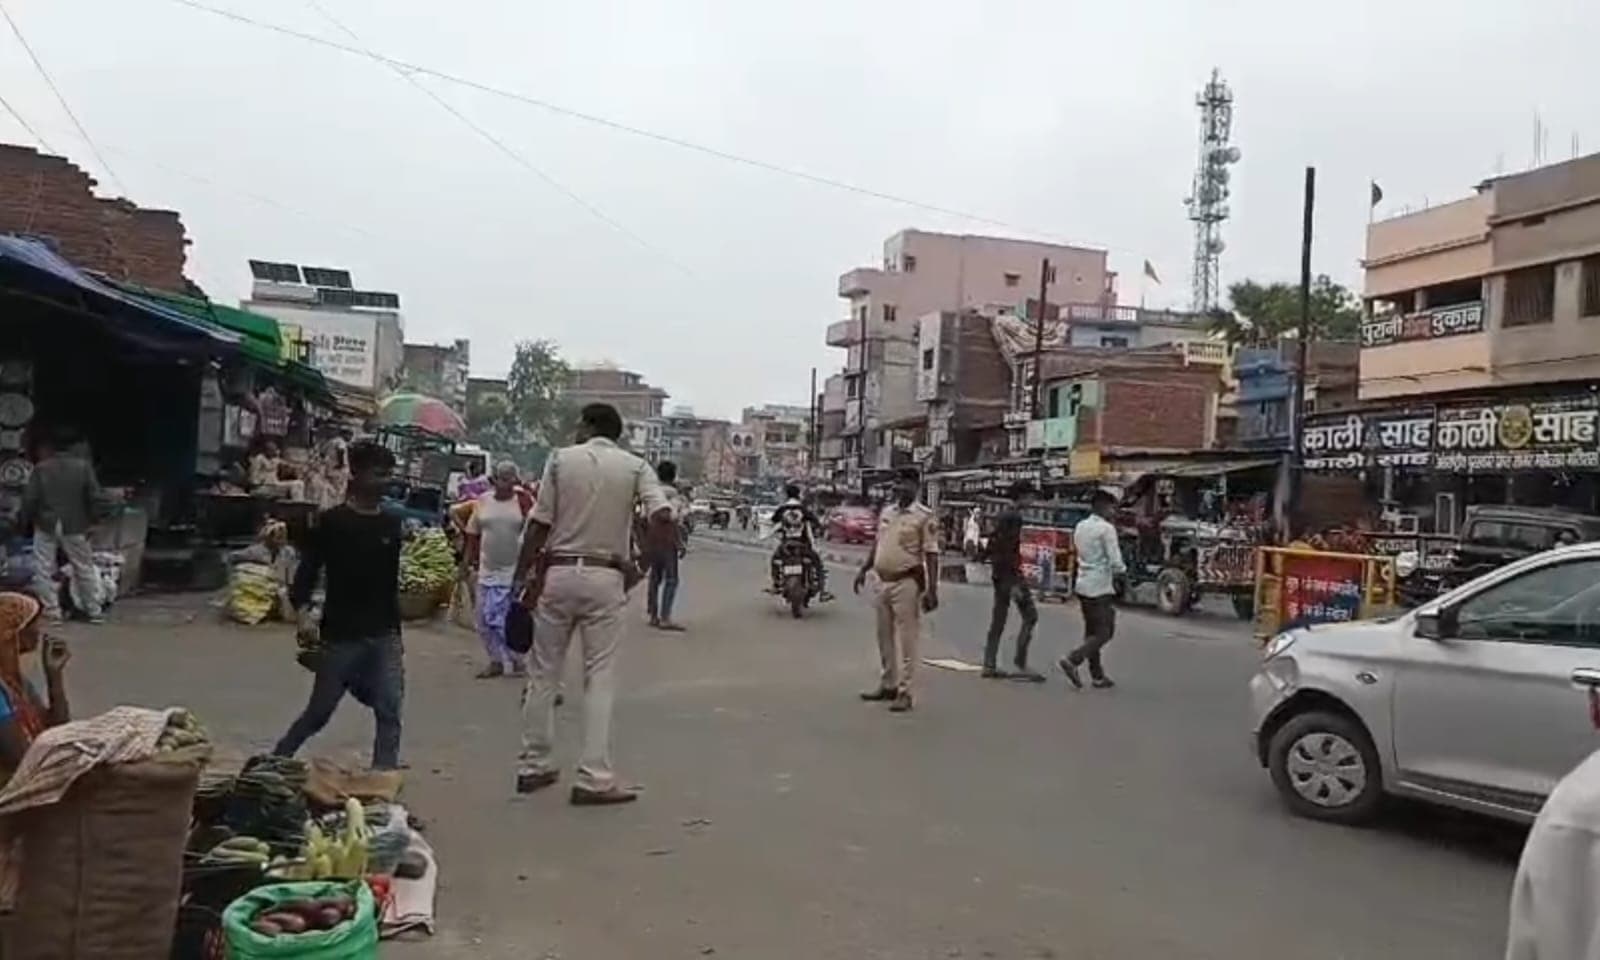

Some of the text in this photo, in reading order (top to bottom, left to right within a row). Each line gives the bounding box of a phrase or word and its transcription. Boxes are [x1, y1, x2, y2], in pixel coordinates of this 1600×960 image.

[1432, 307, 1482, 336] दुकान
[1304, 415, 1433, 449] काली साह
[1438, 409, 1497, 448] काली
[1533, 410, 1598, 442] साह
